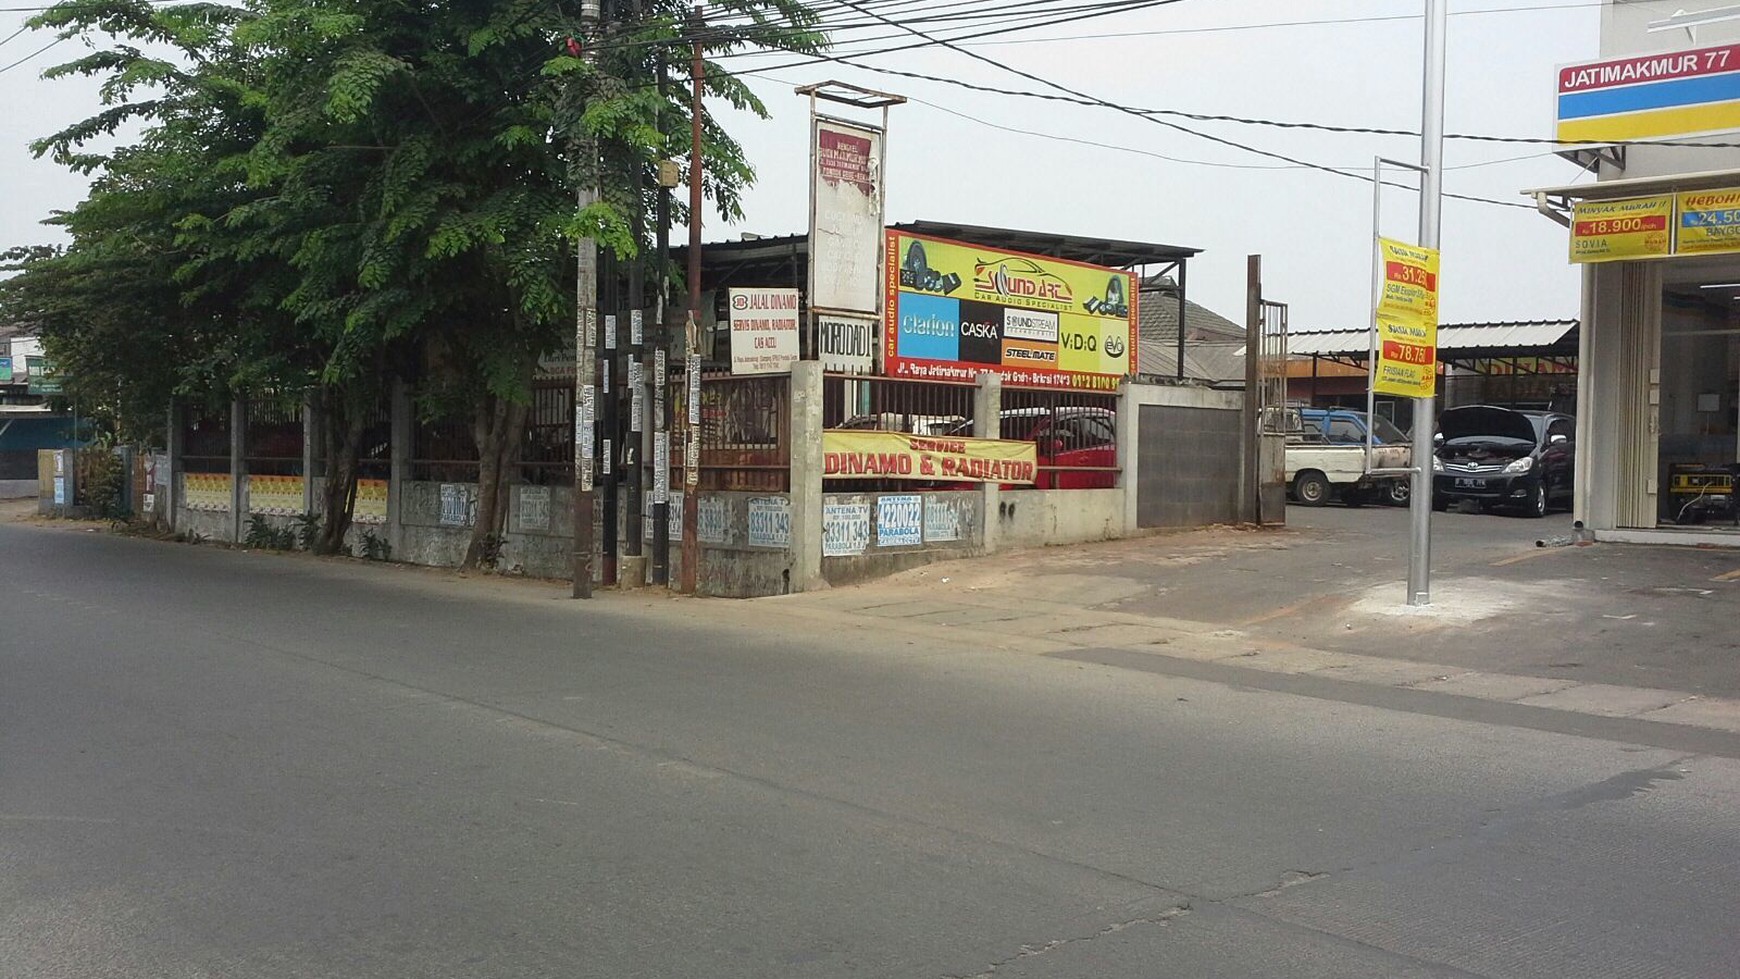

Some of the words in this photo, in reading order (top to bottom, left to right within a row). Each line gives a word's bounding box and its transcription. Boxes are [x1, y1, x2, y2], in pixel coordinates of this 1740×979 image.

[1564, 54, 1698, 88] JATIMAKMUR
[1704, 50, 1731, 70] 77
[1575, 238, 1608, 249] SOVIA
[887, 236, 897, 296] specialist
[974, 291, 992, 301] CAR
[996, 294, 1022, 305] AUDIO
[1025, 298, 1073, 311] SPECIALIST
[887, 299, 895, 334] audio
[960, 321, 998, 340] CASKA
[887, 338, 895, 357] car
[909, 438, 967, 455] SERVICE
[823, 452, 912, 476] DINAMO
[919, 455, 936, 476] &
[941, 456, 1034, 481] RADIATOR
[825, 506, 859, 515] ANTENA
[879, 527, 920, 537] PARABOLA
